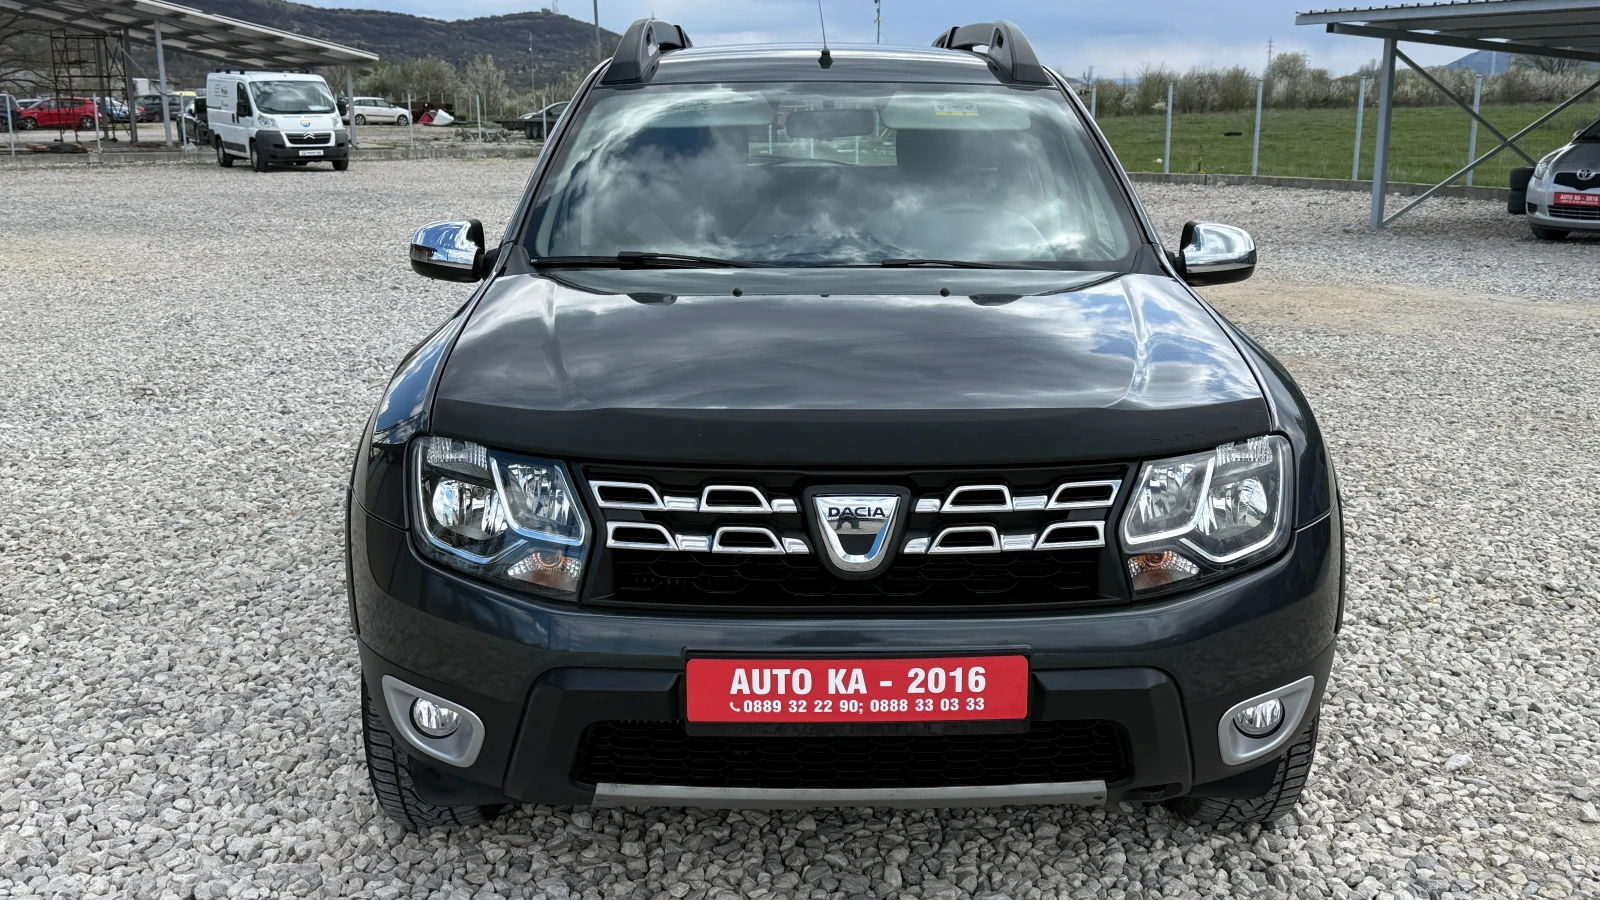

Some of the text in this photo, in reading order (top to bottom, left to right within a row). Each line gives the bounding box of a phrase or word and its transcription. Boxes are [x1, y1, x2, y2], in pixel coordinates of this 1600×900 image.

[828, 507, 885, 517] DACIA
[729, 668, 812, 695] AUTO
[828, 668, 867, 695] KA
[907, 666, 986, 694] 2016
[743, 697, 985, 715] 0889 32 22 90; 0888 33 03 33
